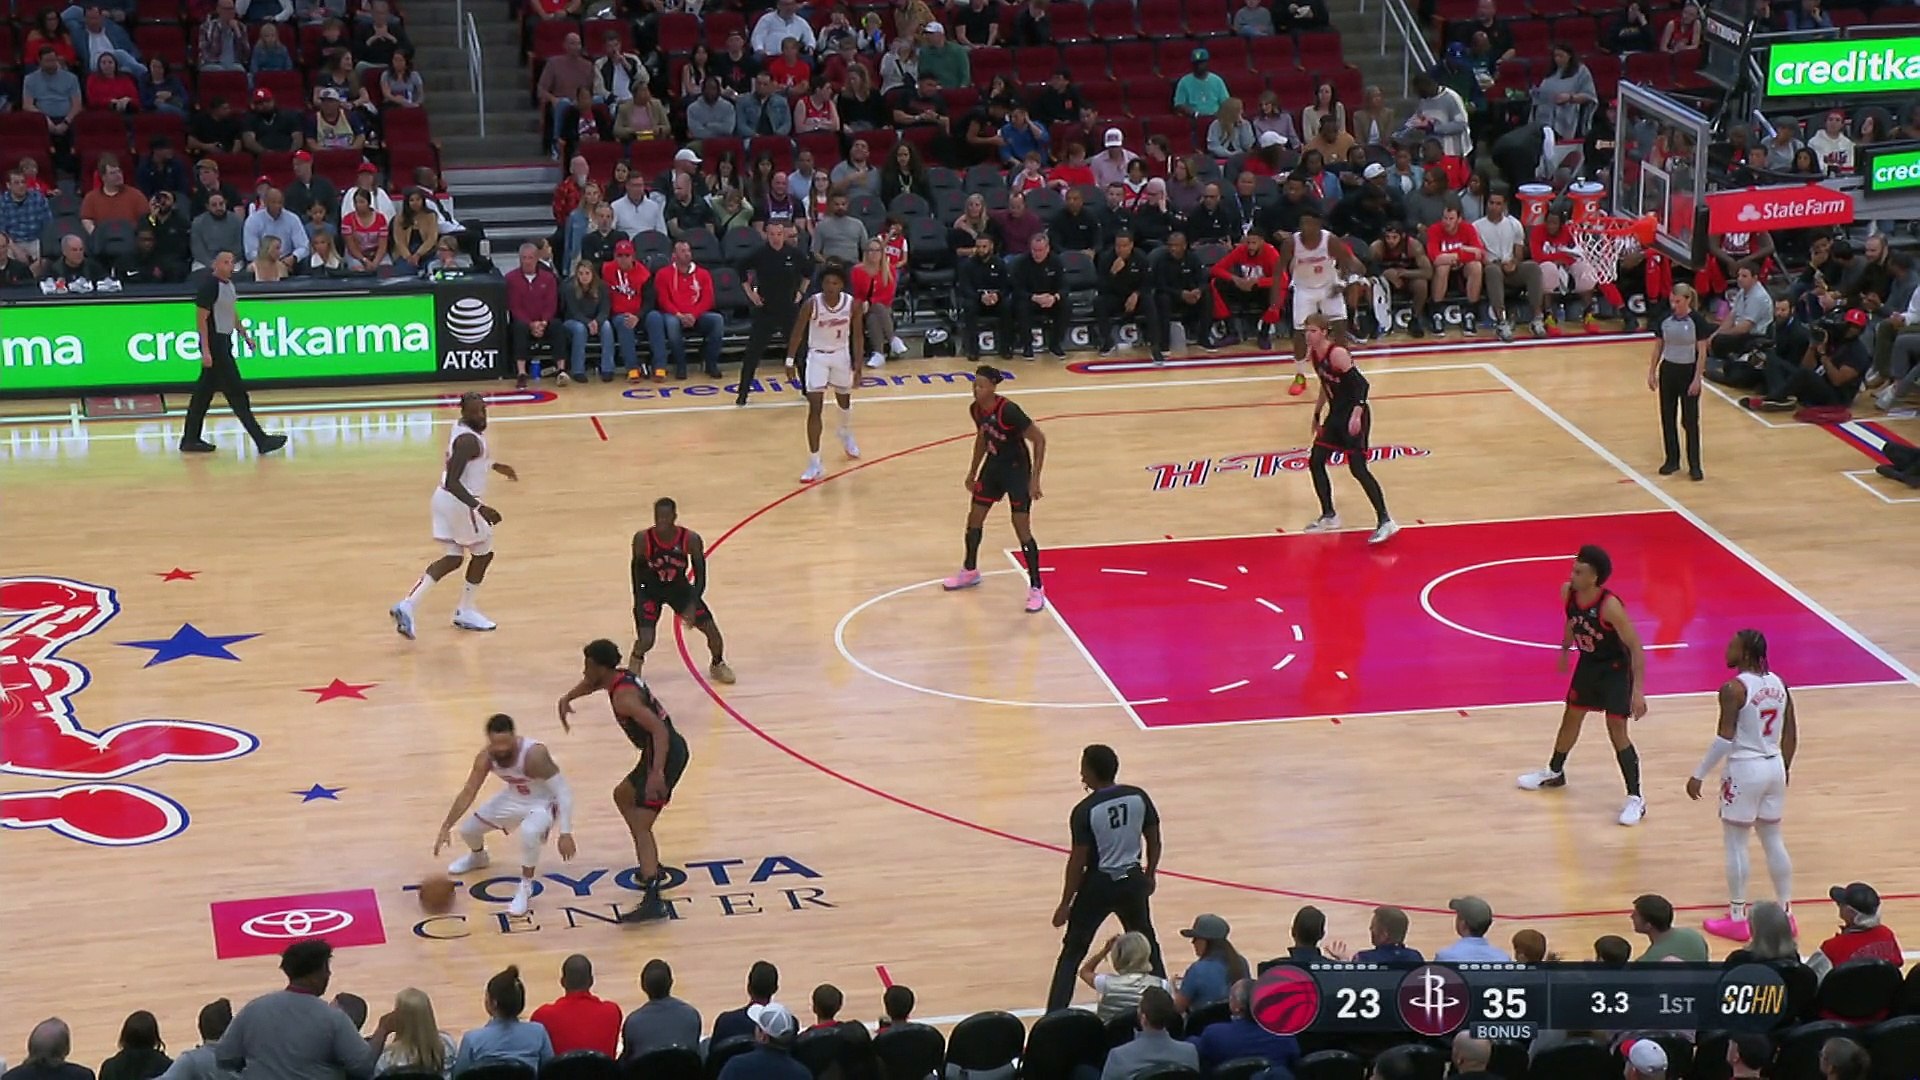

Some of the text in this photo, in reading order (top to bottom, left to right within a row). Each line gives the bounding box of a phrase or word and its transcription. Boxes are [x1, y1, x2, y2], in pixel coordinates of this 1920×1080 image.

[1531, 203, 1542, 215] G
[1585, 201, 1597, 213] G
[1628, 294, 1645, 314] G
[1445, 305, 1462, 324] G
[979, 331, 995, 350] G
[1070, 326, 1089, 345] G
[1119, 323, 1138, 343] G
[1, 333, 84, 367] ma
[442, 349, 499, 370] AT&T
[1760, 708, 1778, 737] 7
[1107, 803, 1129, 829] 27
